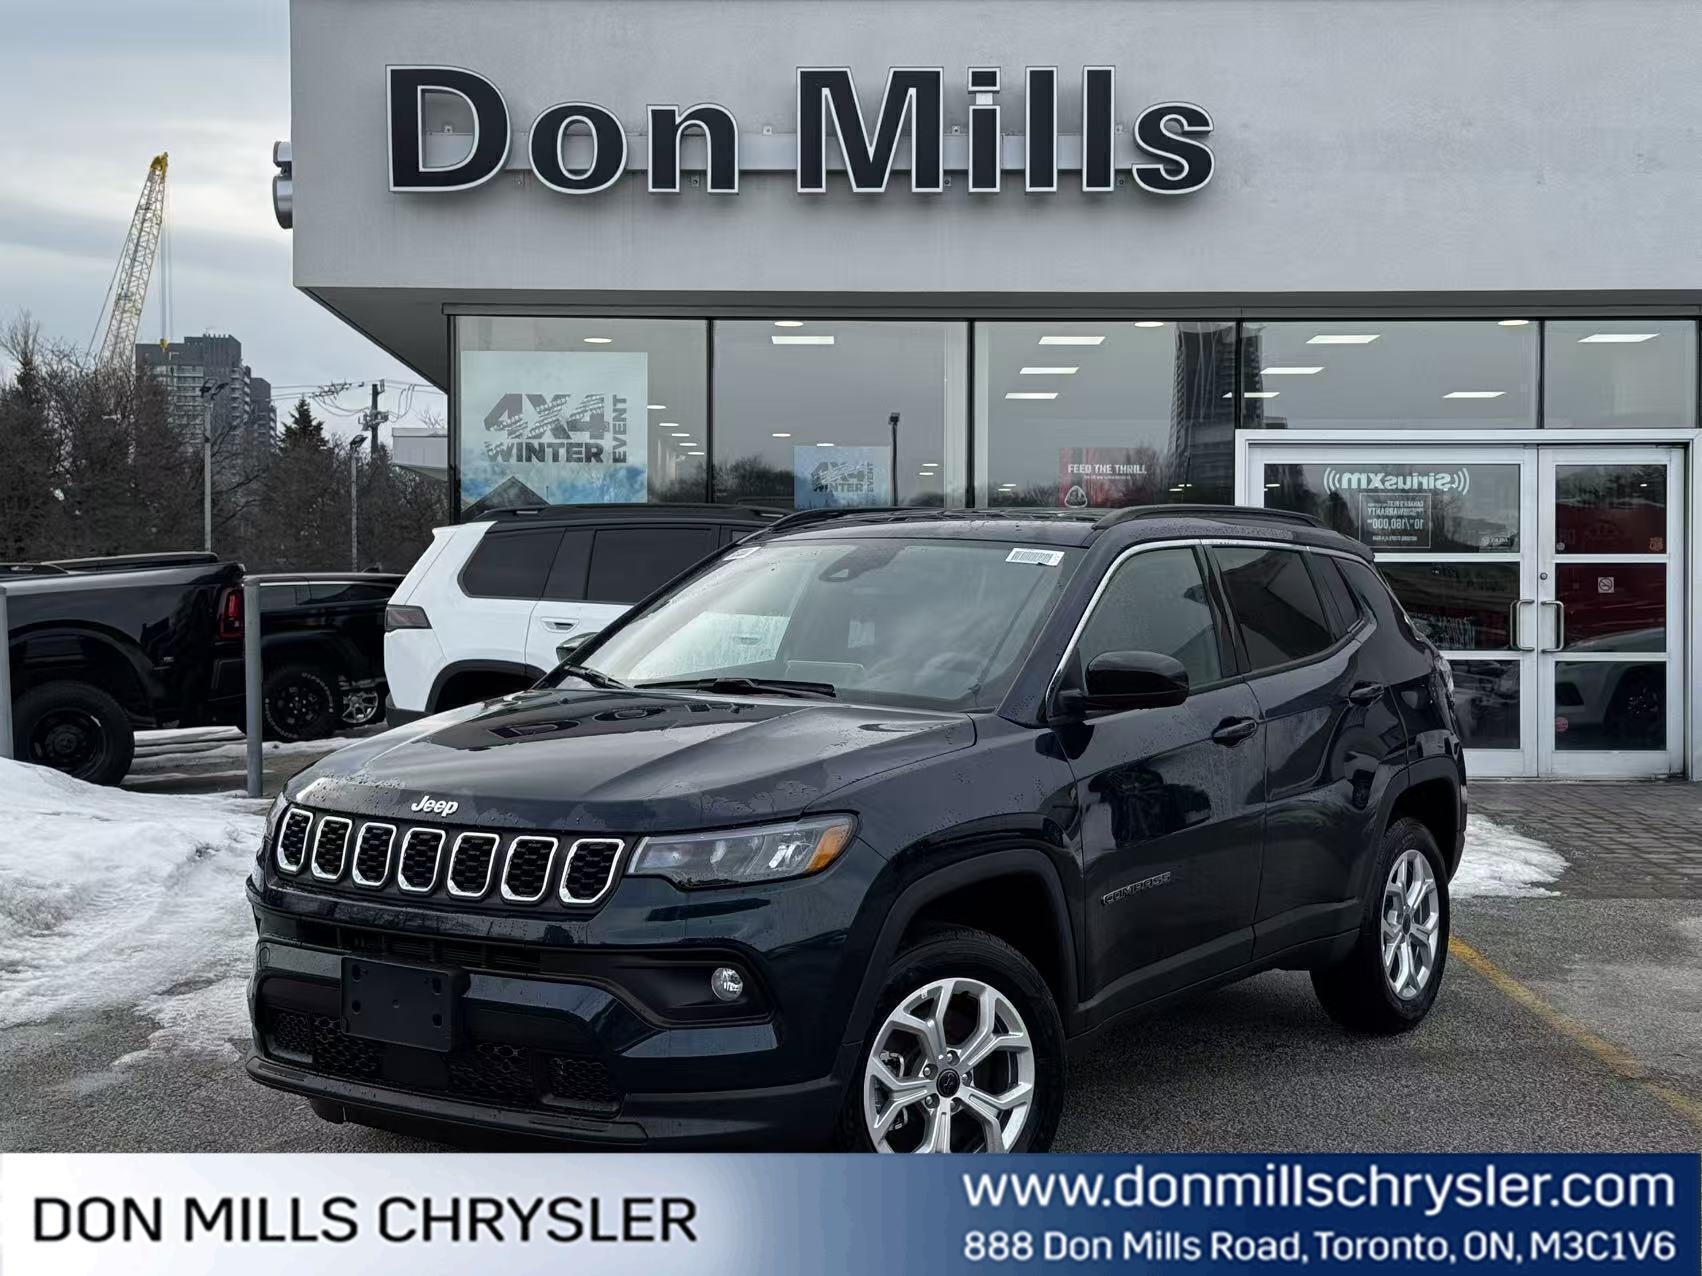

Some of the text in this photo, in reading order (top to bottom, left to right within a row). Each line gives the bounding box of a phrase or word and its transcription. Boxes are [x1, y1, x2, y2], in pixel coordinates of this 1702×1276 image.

[385, 65, 1215, 196] Don Mills
[612, 394, 627, 463] EVENT
[484, 441, 604, 463] WINTER
[1067, 464, 1092, 474] FEED
[1094, 464, 1113, 474] THE
[411, 795, 459, 817] Jeep
